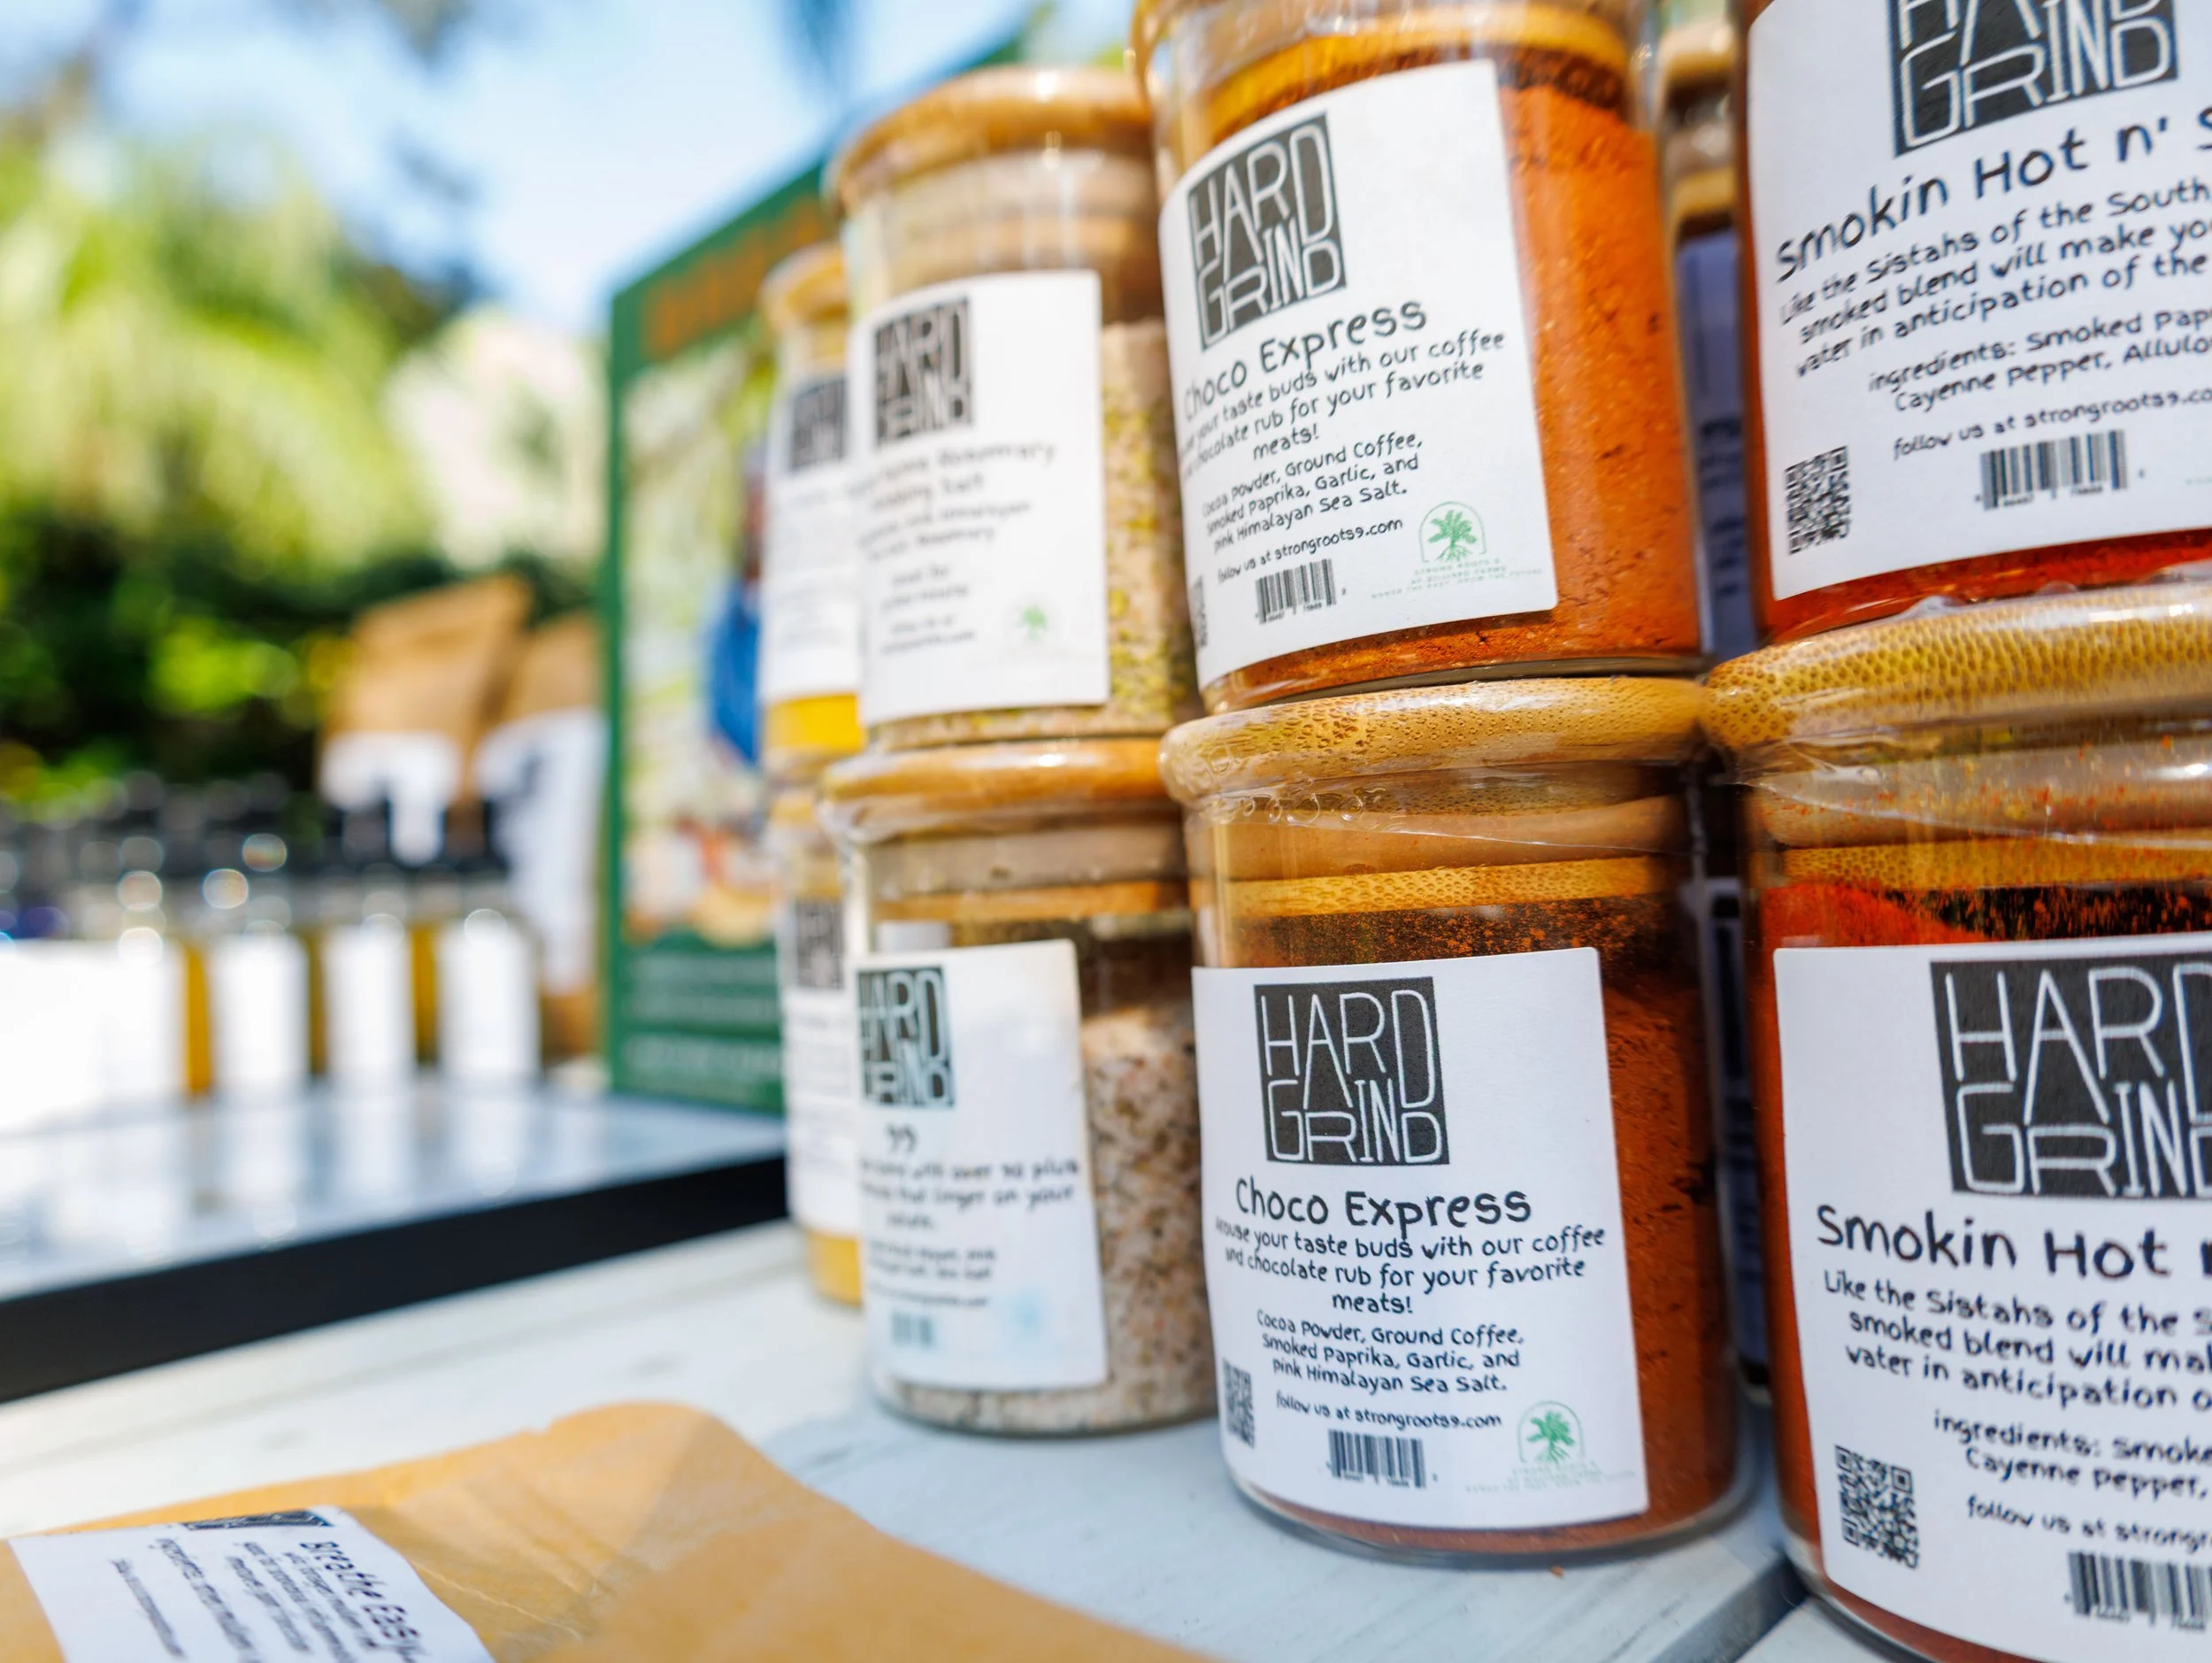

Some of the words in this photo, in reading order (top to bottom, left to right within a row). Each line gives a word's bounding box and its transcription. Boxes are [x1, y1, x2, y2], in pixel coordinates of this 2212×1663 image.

[1901, 0, 2171, 148] GRIND
[1189, 124, 1333, 283] HARD
[1776, 173, 1950, 284] Smokin
[1974, 127, 2089, 199] Hot
[2117, 116, 2168, 163] n'
[1822, 270, 1858, 301] the
[1866, 231, 1979, 284] Sistahs
[1991, 209, 2028, 243] of
[2039, 201, 2093, 229] the
[2107, 175, 2211, 217] South
[1897, 260, 1978, 306] blend
[1991, 242, 2047, 278] will
[2059, 223, 2155, 260] make
[2168, 219, 2212, 252] yo
[1197, 214, 1342, 348] GRIND
[1860, 324, 1885, 350] in
[1895, 273, 2088, 340] anticipation
[2101, 254, 2141, 289] of
[2153, 249, 2208, 278] the
[1184, 360, 1248, 421] Choco
[1260, 301, 1427, 372] Express
[1223, 391, 1263, 421] taste
[1269, 372, 1317, 402] buds
[1325, 352, 1372, 382] with
[1379, 344, 1419, 368] our
[1428, 327, 1504, 358] coffee
[1868, 341, 2016, 394] ingredients:
[2026, 315, 2142, 352] Smoked
[2154, 308, 2212, 332] Pap
[1895, 373, 1996, 412] Cayenne
[2007, 352, 2112, 387] Pepper,
[2123, 334, 2212, 363] Allulo
[1255, 411, 1283, 436] rub
[1290, 397, 1320, 426] for
[1326, 381, 1377, 418] your
[1386, 359, 1485, 398] favorite
[1232, 470, 1281, 501] Powder,
[1286, 445, 1347, 476] Ground
[1354, 431, 1424, 458] Coffee,
[1252, 423, 1319, 461] meats!
[1893, 432, 1953, 461] follow
[1959, 423, 1985, 441] us
[1994, 414, 2016, 434] at
[1237, 504, 1313, 542] Himalayan
[1319, 494, 1353, 513] Sea
[1359, 480, 1408, 503] Salt.
[1248, 482, 1310, 516] Paprika,
[1314, 464, 1376, 490] Garlic,
[1383, 452, 1419, 474] and
[1243, 558, 1256, 571] us
[1260, 550, 1271, 565] at
[1275, 518, 1403, 559] strongroots9.com
[1260, 989, 1435, 1110] HARD
[1267, 1077, 1443, 1164] GRIND
[1236, 1175, 1328, 1225] Choco
[1345, 1190, 1531, 1240] Express
[1248, 1251, 1327, 1282] chocolate
[1334, 1266, 1371, 1286] rub
[1379, 1263, 1415, 1290] for
[1422, 1269, 1479, 1296] your
[1486, 1256, 1586, 1289] favorite
[1254, 1230, 1288, 1251] your
[1294, 1230, 1348, 1256] taste
[1355, 1238, 1414, 1259] buds
[1421, 1235, 1472, 1260] with
[1481, 1237, 1523, 1257] our
[1532, 1224, 1605, 1254] coffee
[1816, 1204, 2017, 1268] Smokin
[2043, 1227, 2172, 1280] Hot
[1256, 1308, 1295, 1334] Cocoa
[1301, 1320, 1366, 1343] Powder,
[1371, 1326, 1444, 1345] Ground
[1450, 1324, 1525, 1349] Coffee,
[1332, 1292, 1414, 1314] meats!
[1824, 1269, 1866, 1301] Like
[1874, 1279, 1916, 1311] the
[1925, 1290, 2054, 1328] Sistahs
[2066, 1299, 2106, 1337] of
[2120, 1302, 2178, 1336] the
[1323, 1345, 1401, 1370] Paprika,
[1406, 1350, 1474, 1370] Garlic,
[1482, 1349, 1521, 1368] and
[1849, 1311, 1953, 1351] smoked
[1963, 1328, 2054, 1366] blend
[2069, 1337, 2129, 1369] will
[1276, 1390, 1310, 1414] follow
[1314, 1403, 1331, 1418] us
[1335, 1405, 1351, 1420] at
[1355, 1407, 1502, 1431] strongroots9.com
[1306, 1366, 1403, 1396] Himalayan
[1409, 1375, 1449, 1393] Sea
[1455, 1374, 1508, 1394] Salt.
[1924, 1354, 1949, 1379] in
[1962, 1367, 2177, 1411] anticipation
[1933, 1408, 2101, 1458] ingredients:
[1965, 1446, 2081, 1484] Cayenne
[2093, 1467, 2208, 1501] Pepper,
[1966, 1493, 2035, 1527] follow
[2040, 1513, 2070, 1534] us
[2082, 1516, 2107, 1537] at
[2115, 1521, 2212, 1555] strongr
